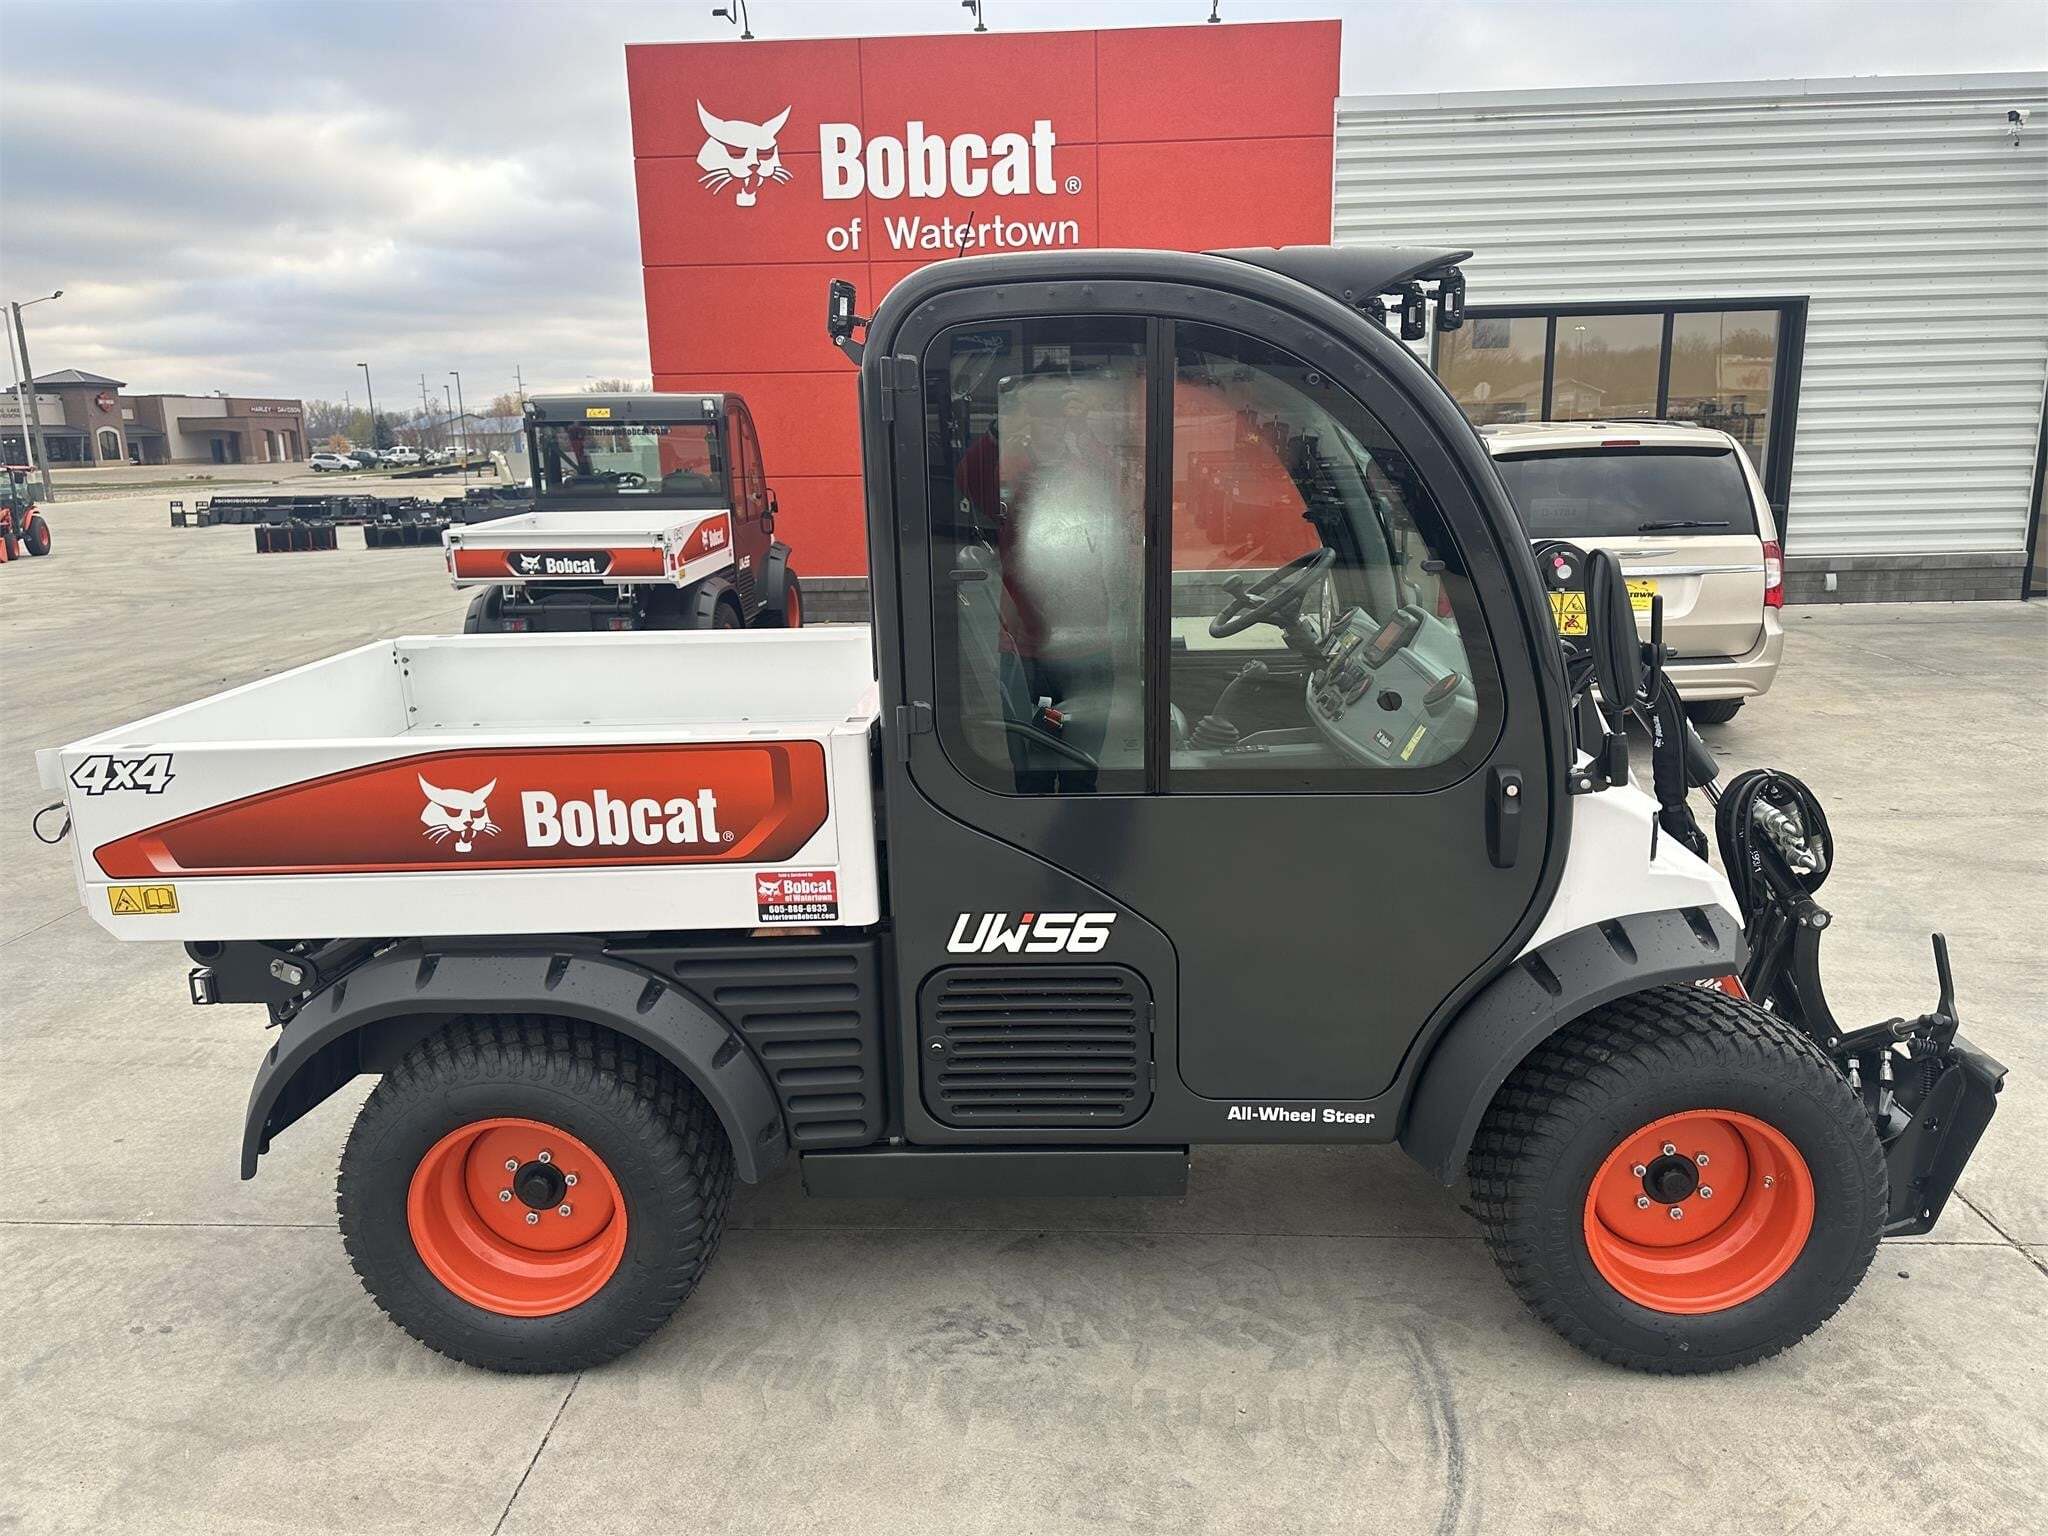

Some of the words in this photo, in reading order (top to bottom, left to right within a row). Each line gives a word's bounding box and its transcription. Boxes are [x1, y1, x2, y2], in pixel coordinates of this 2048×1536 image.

[819, 120, 1057, 199] Bobcat
[826, 217, 862, 251] of
[884, 214, 1079, 251] Watertown
[545, 557, 597, 574] Bobcat
[70, 753, 176, 795] 4x4
[521, 788, 720, 847] Bobcat
[783, 879, 832, 894] Bobcat
[946, 912, 1118, 953] UW56
[1227, 1105, 1316, 1122] All-Wheel
[1322, 1108, 1376, 1124] Steer
